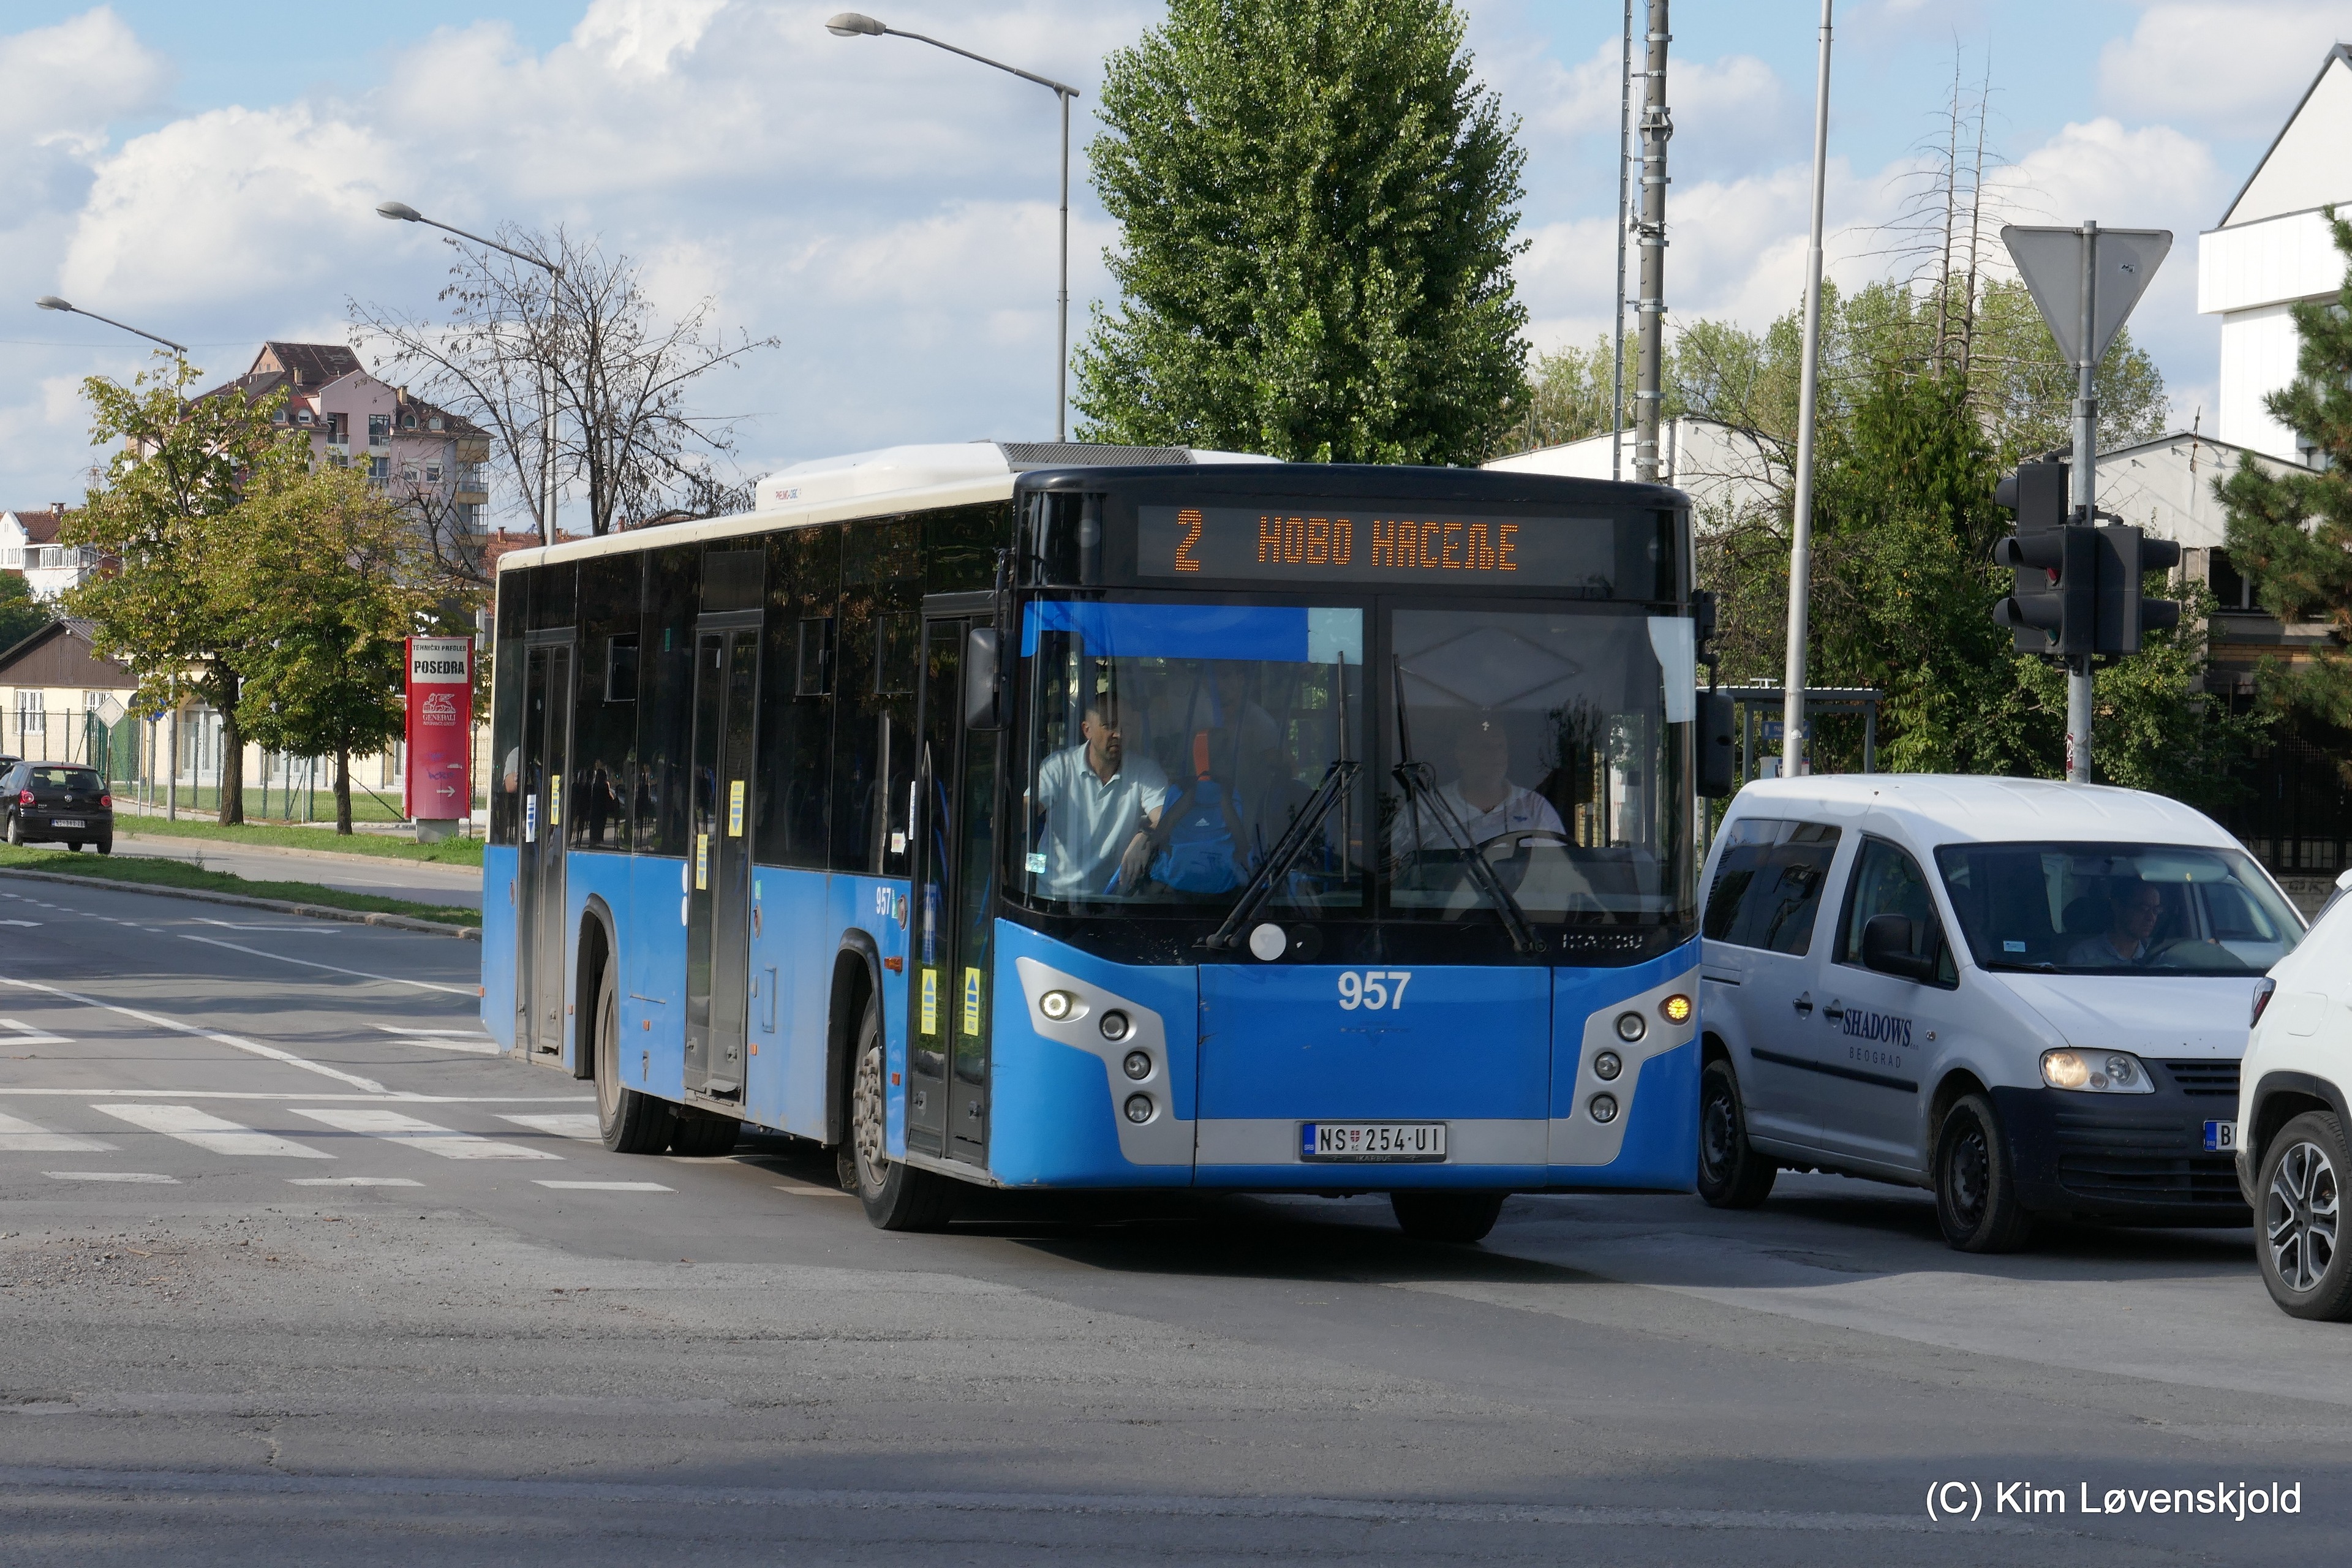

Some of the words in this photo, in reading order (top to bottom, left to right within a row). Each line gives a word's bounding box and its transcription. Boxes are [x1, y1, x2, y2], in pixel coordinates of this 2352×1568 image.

[1175, 509, 1202, 571] 2
[1259, 516, 1352, 565] НОВО
[1372, 520, 1518, 571] НАСЕЉЕ
[414, 660, 465, 674] POSEDRA
[876, 887, 891, 915] 957
[1338, 971, 1411, 1010] 957
[1844, 1008, 1912, 1047] SHADOWS
[1850, 1047, 1901, 1068] BEOGRAD
[1320, 1128, 1346, 1151] NS
[2222, 1125, 2238, 1146] B
